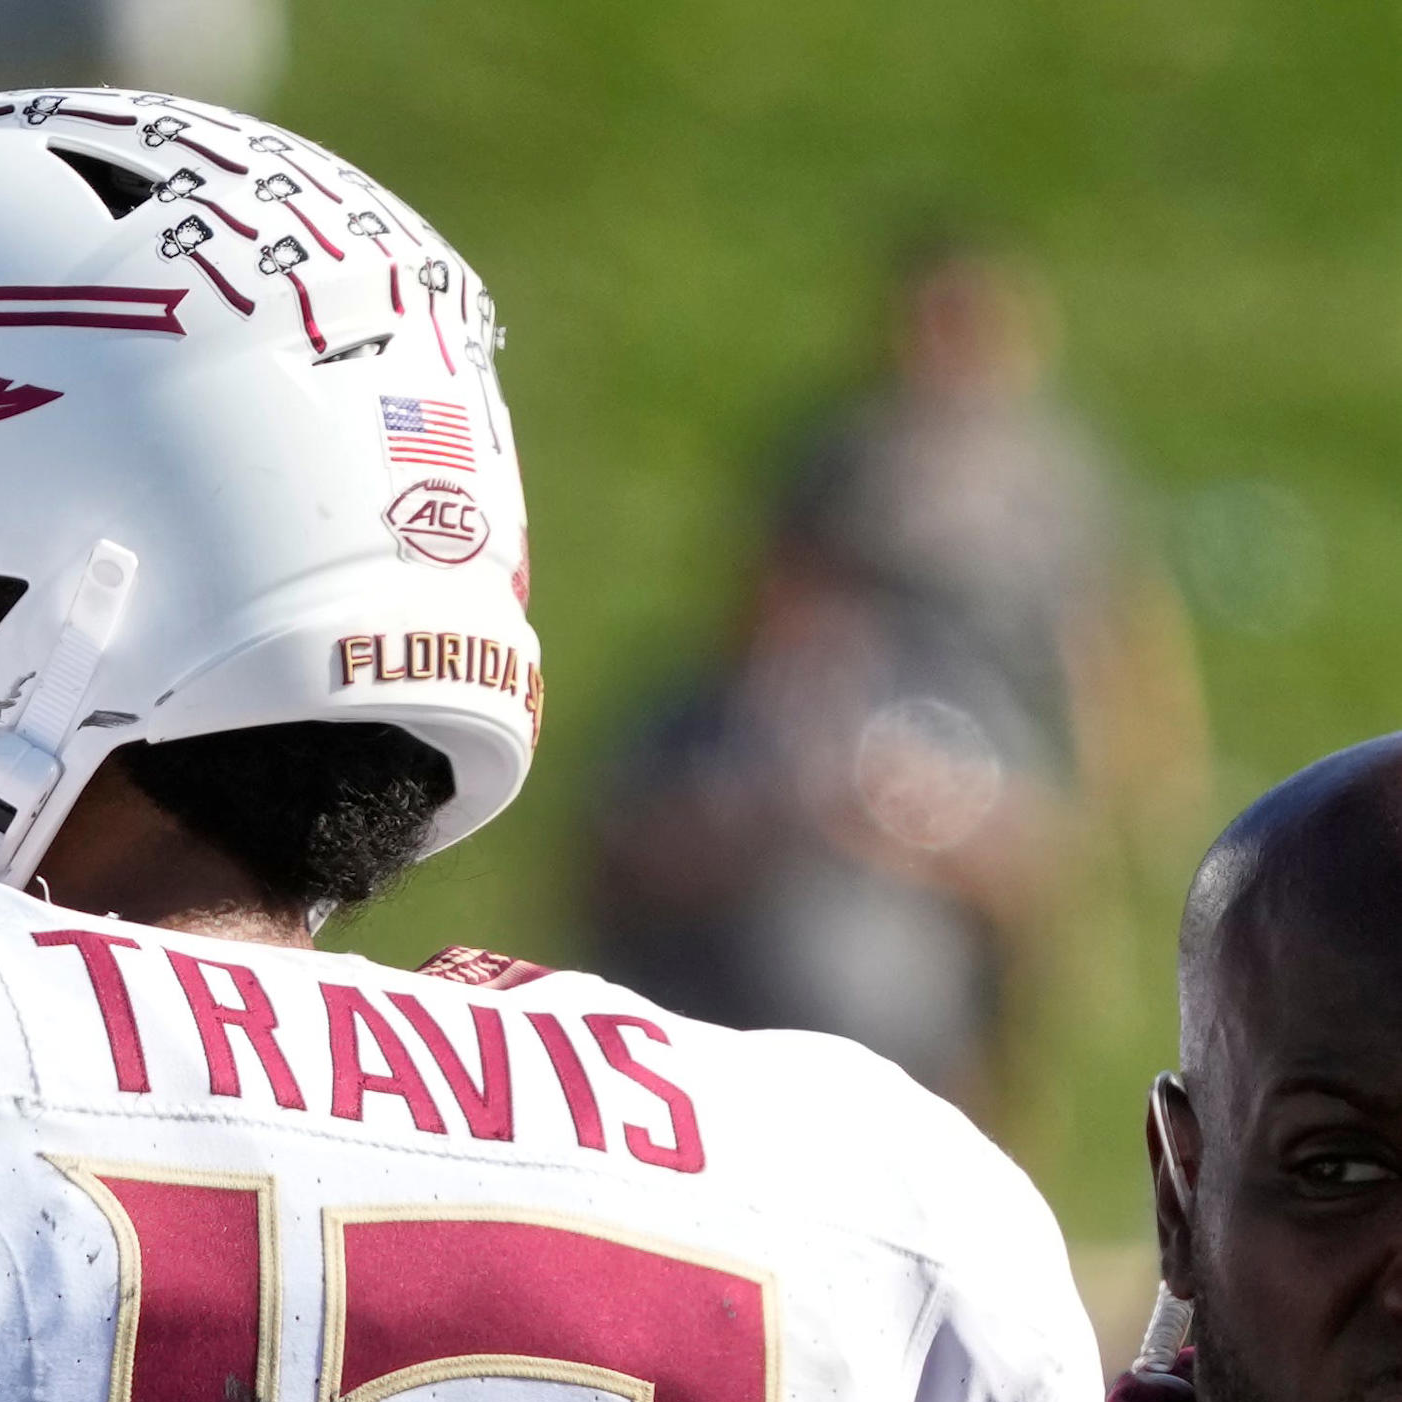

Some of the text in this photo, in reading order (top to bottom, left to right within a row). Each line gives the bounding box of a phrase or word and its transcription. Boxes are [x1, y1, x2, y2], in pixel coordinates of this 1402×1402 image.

[407, 500, 479, 533] ACC
[338, 631, 518, 697] FLORIDA
[30, 929, 708, 1175] TRAVIS
